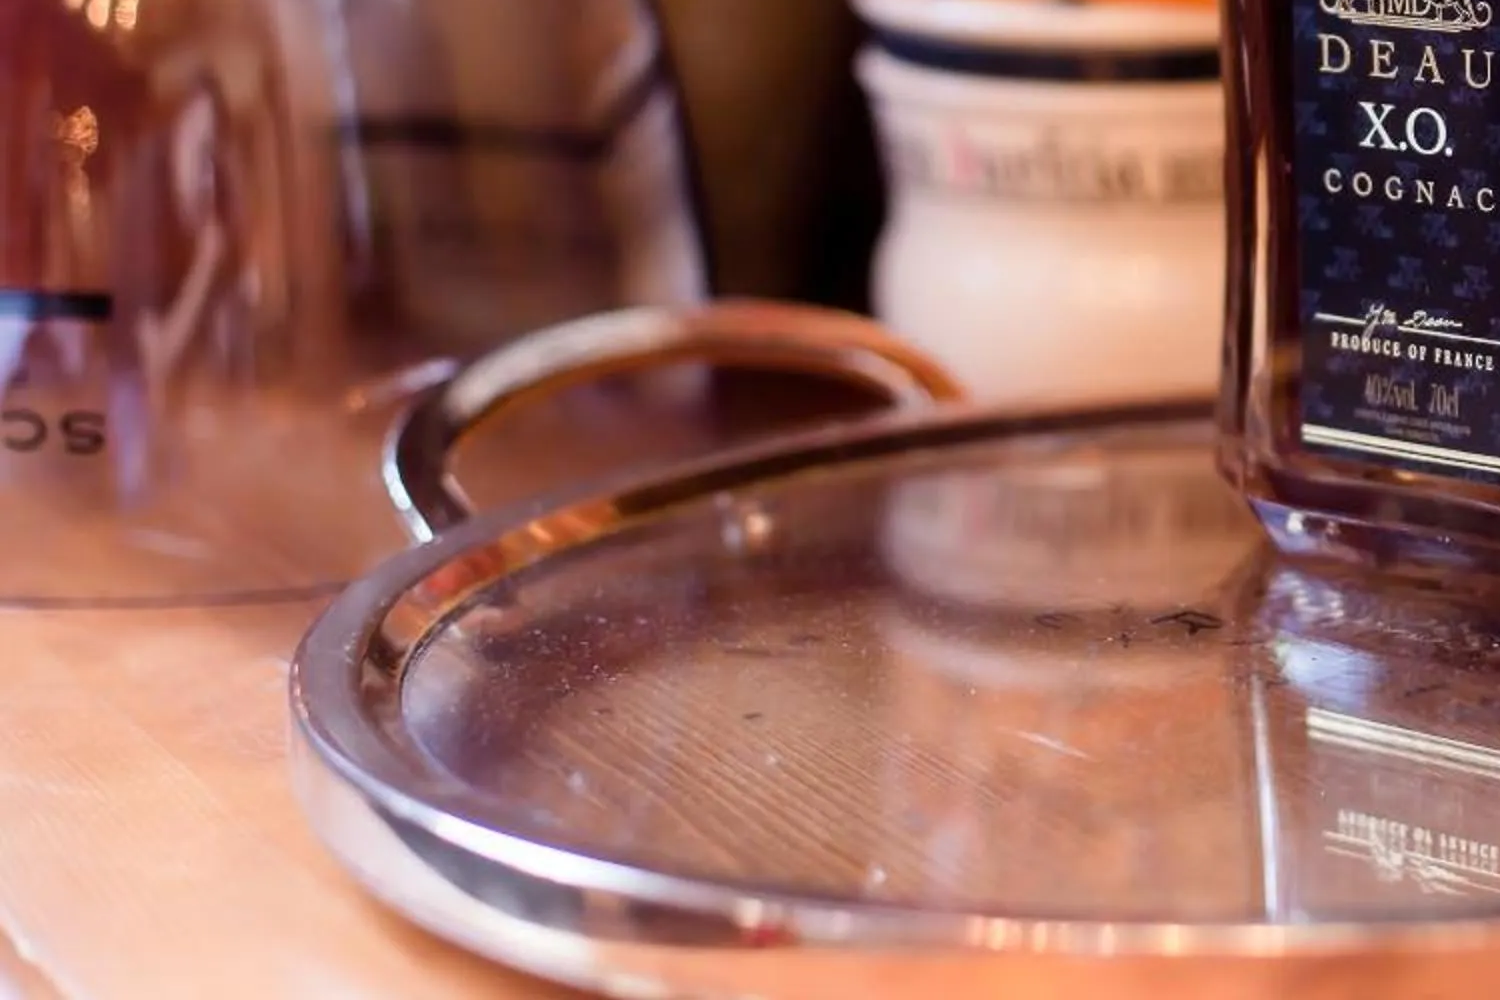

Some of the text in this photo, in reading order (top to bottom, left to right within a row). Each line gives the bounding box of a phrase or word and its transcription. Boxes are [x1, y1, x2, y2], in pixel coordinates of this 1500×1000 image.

[1317, 33, 1494, 89] DEAU
[1358, 101, 1453, 157] X.O.
[1322, 168, 1496, 212] COGNAC
[1330, 331, 1495, 371] PRODUCE OF FRANCE
